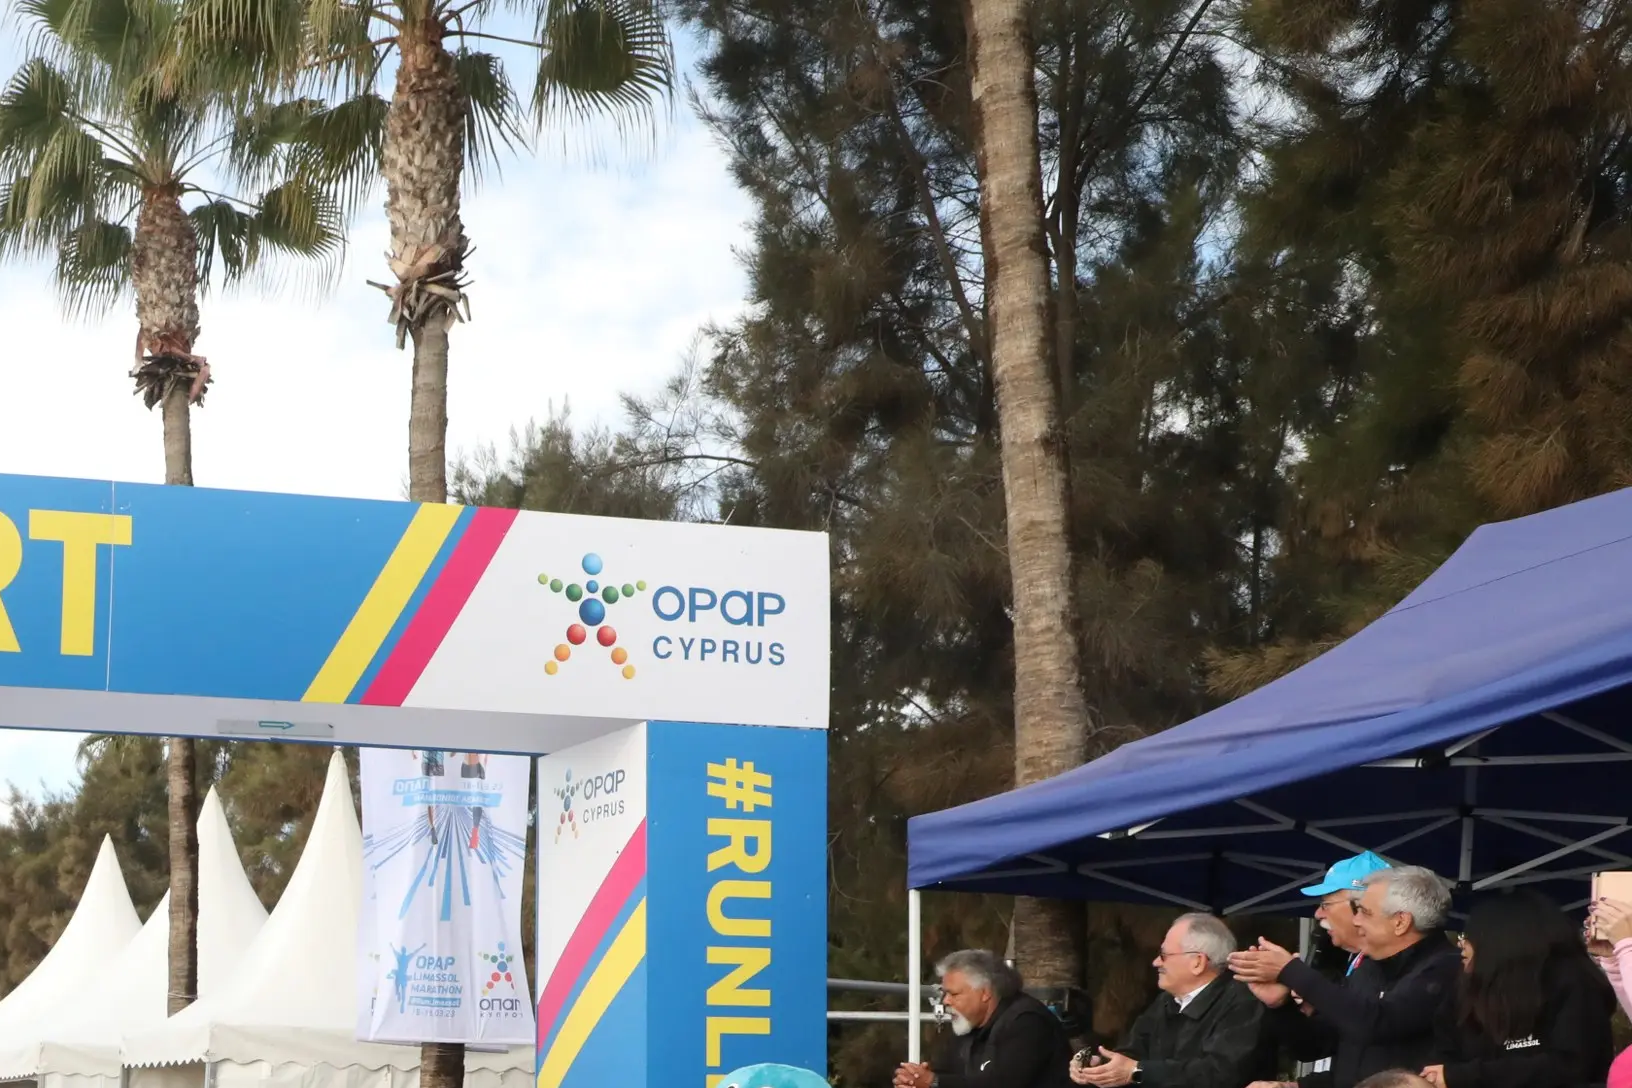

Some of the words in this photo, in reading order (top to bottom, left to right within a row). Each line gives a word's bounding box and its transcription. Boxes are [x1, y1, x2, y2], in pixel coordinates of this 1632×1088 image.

[652, 635, 786, 666] CYPRUS
[582, 799, 625, 823] CYPRUS
[415, 955, 456, 971] OPAP
[413, 973, 460, 983] LIMASSOL
[410, 983, 463, 995] MARATHON
